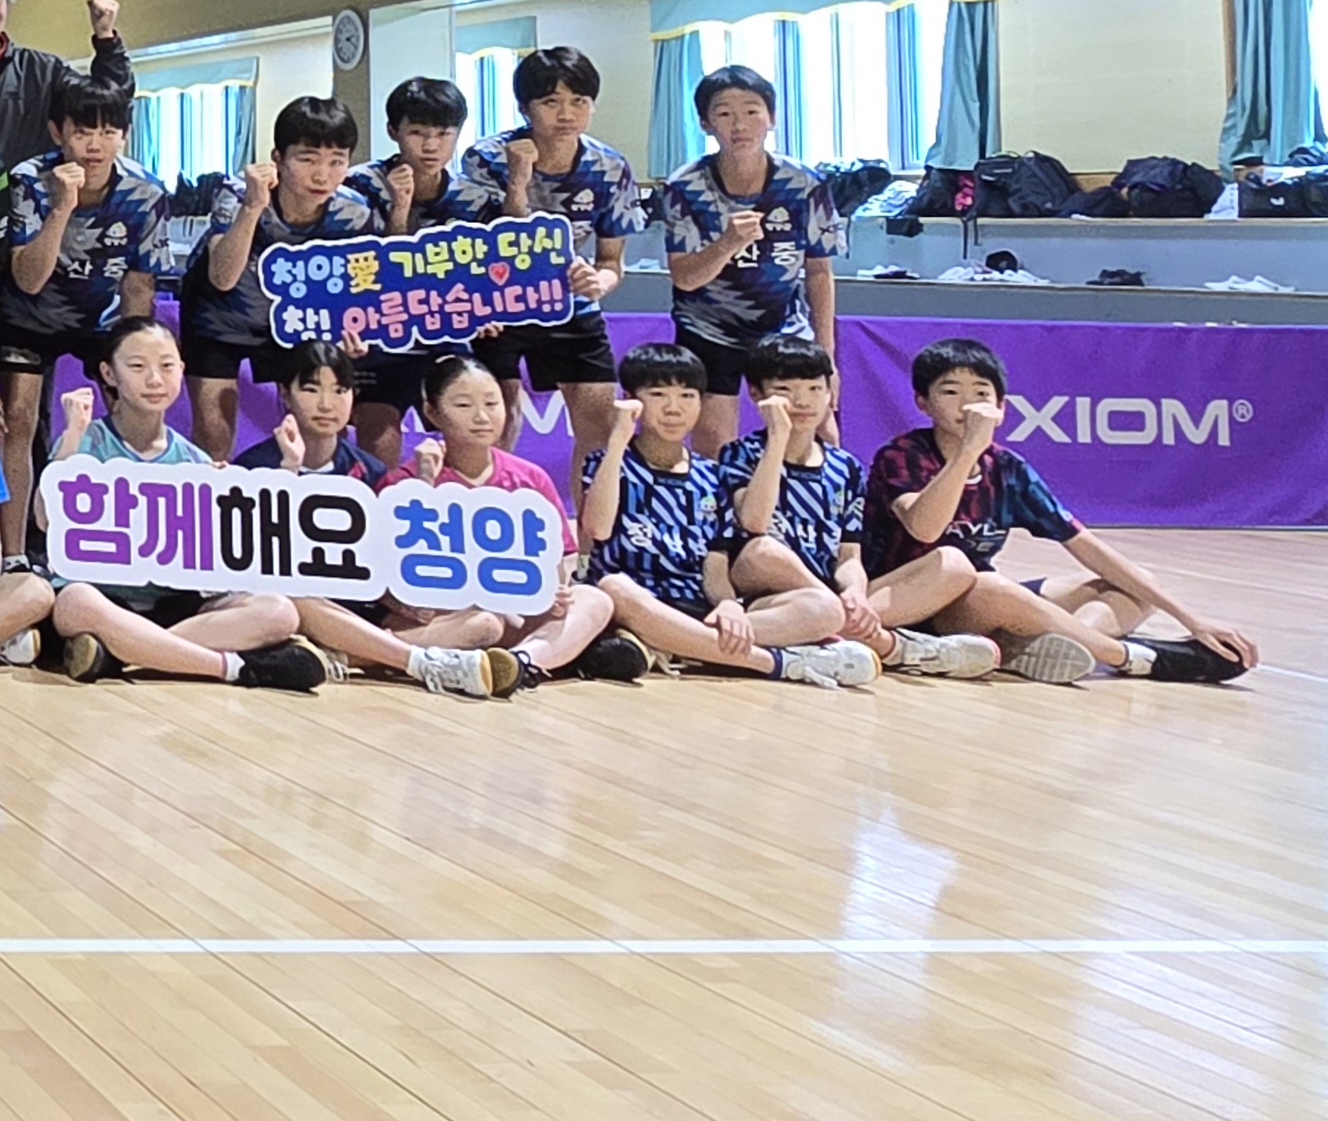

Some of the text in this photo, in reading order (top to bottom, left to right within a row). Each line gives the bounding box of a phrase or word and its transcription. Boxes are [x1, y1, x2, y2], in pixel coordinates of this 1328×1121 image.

[388, 235, 489, 279] 기부한
[497, 225, 566, 271] 당신
[57, 473, 548, 596] 함께해요 청양
